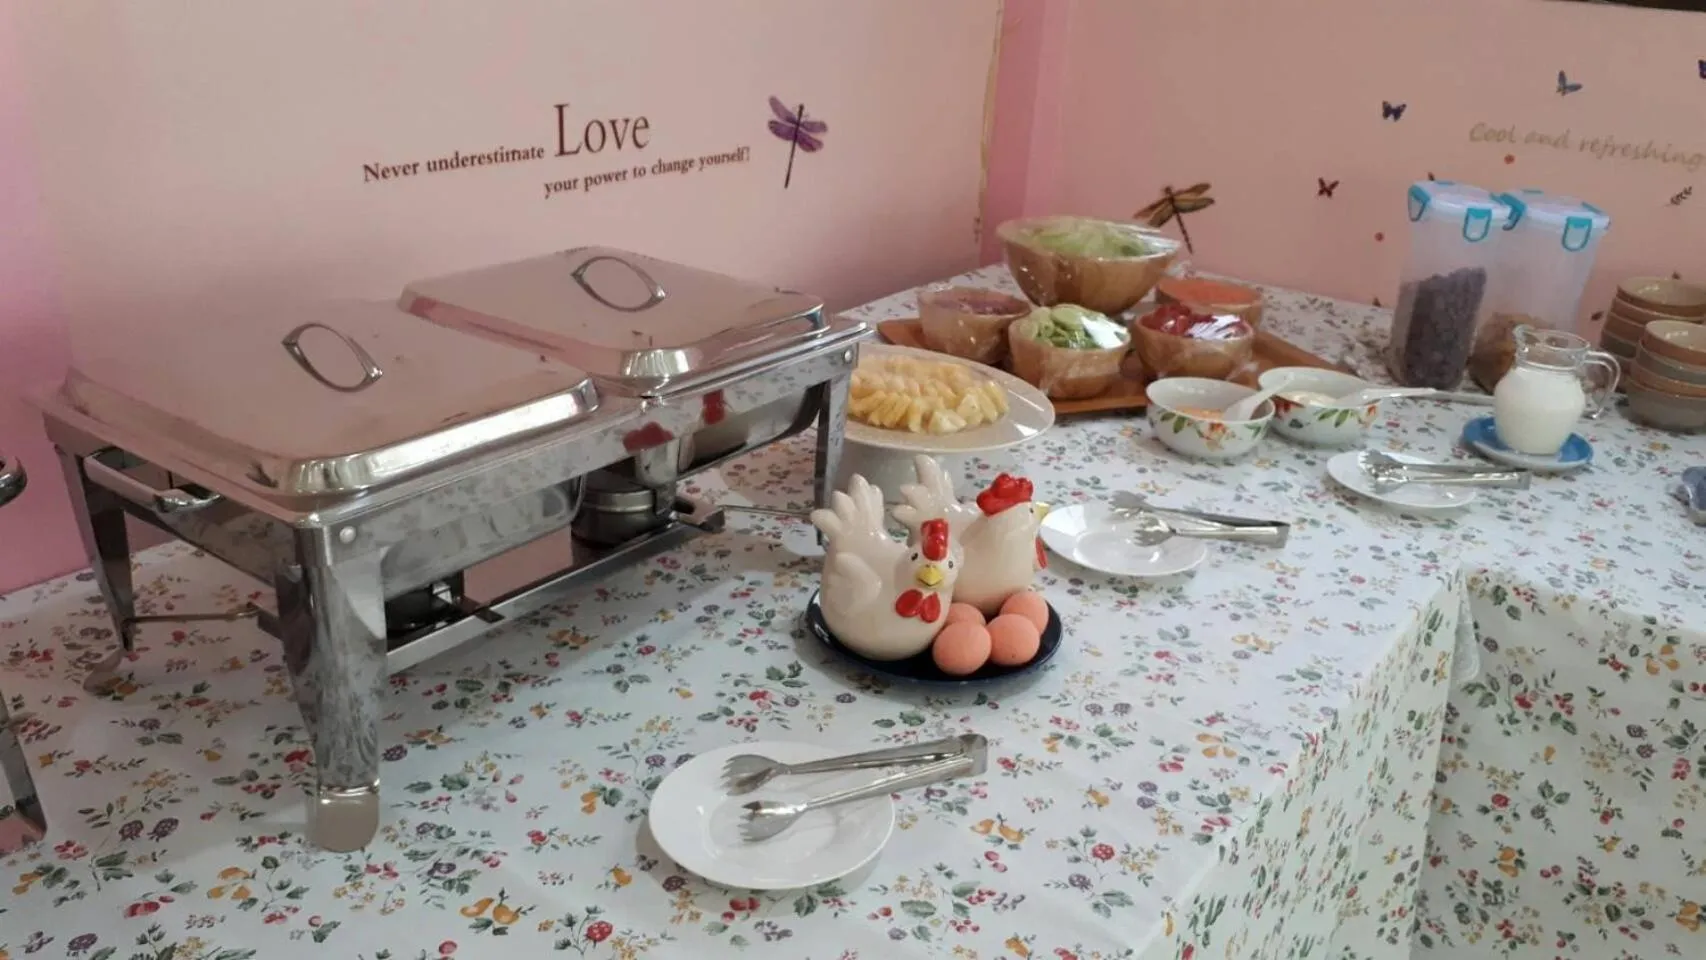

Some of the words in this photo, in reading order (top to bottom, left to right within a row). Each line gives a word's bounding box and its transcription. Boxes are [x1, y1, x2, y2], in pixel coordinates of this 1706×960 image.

[362, 161, 420, 183] Never
[426, 145, 545, 173] underestimate
[553, 102, 651, 158] Love
[1469, 121, 1517, 145] Cool
[1523, 127, 1571, 150] and
[1578, 134, 1706, 173] refreshing
[543, 173, 580, 199] your
[583, 164, 629, 192] power
[632, 161, 648, 179] to
[651, 157, 696, 175] change
